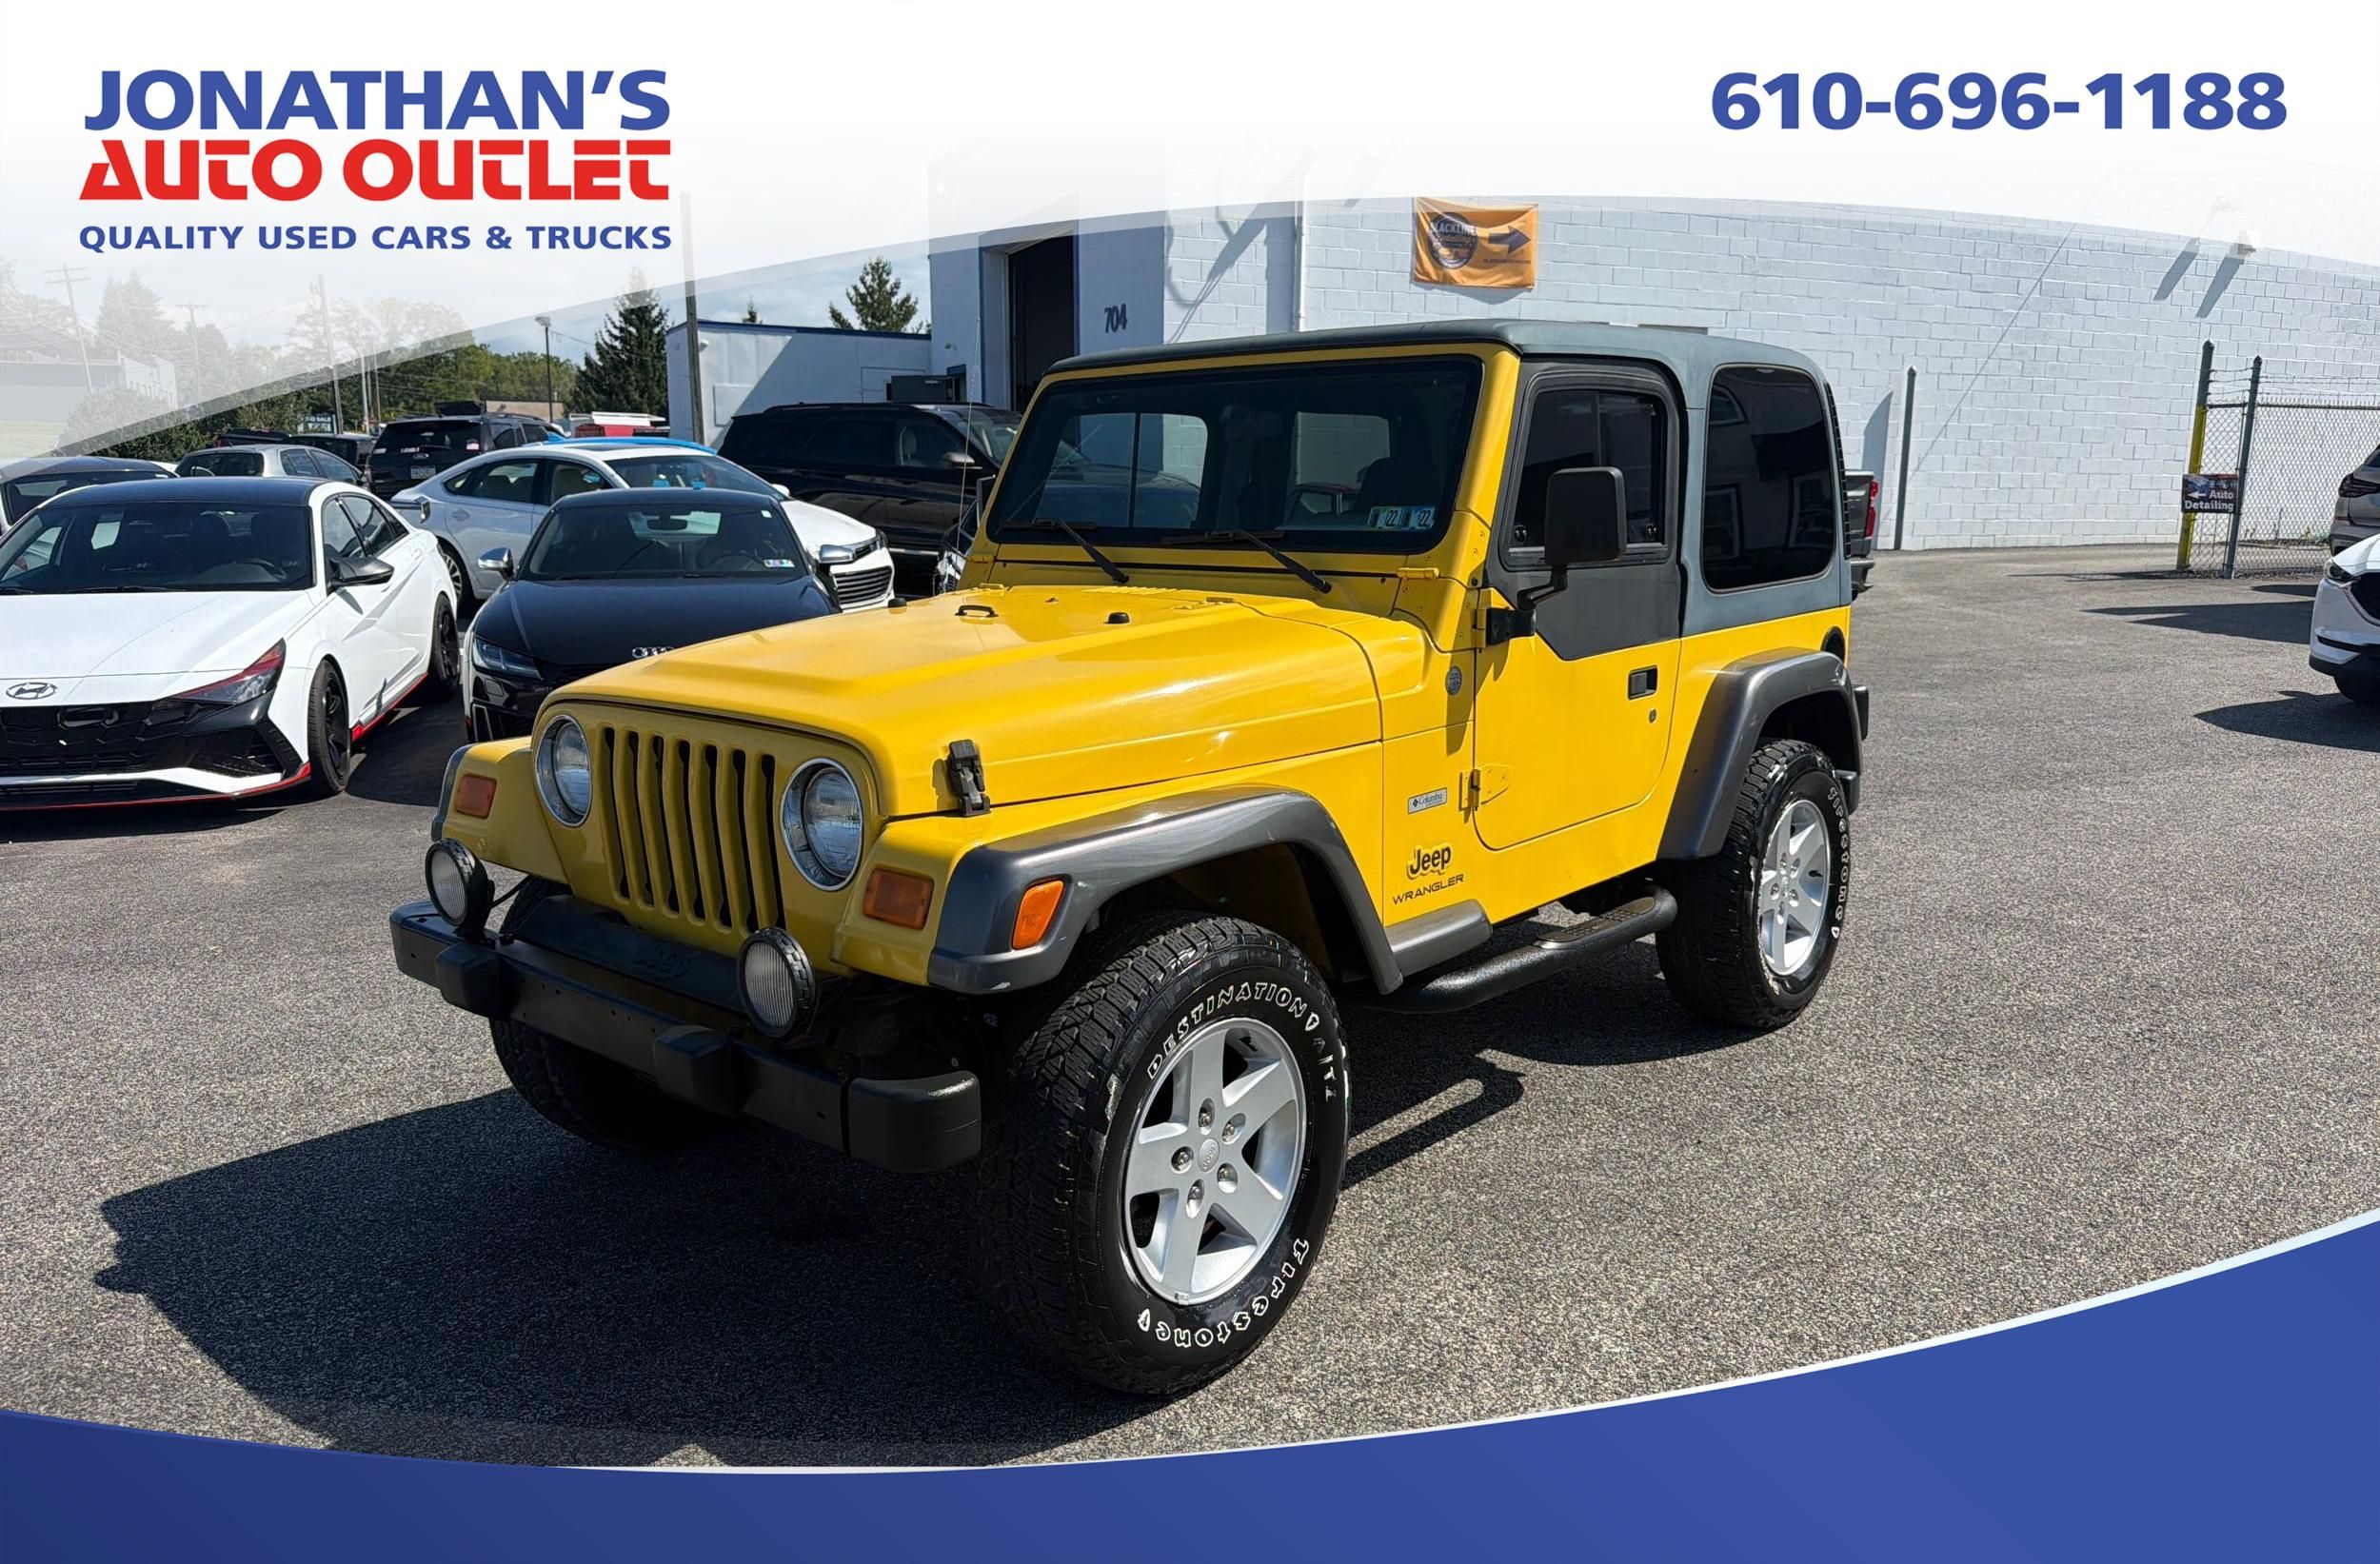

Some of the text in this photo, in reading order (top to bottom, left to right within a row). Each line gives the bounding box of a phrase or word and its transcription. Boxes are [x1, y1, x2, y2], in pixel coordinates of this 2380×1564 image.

[1103, 303, 1128, 334] 704
[2184, 500, 2234, 512] Detailing
[2208, 489, 2234, 500] Auto
[1409, 844, 1452, 875] Jeep
[1392, 873, 1464, 905] WRANGLER
[1146, 981, 1309, 1080] DESTINATION
[1155, 1237, 1311, 1348] Firestone
